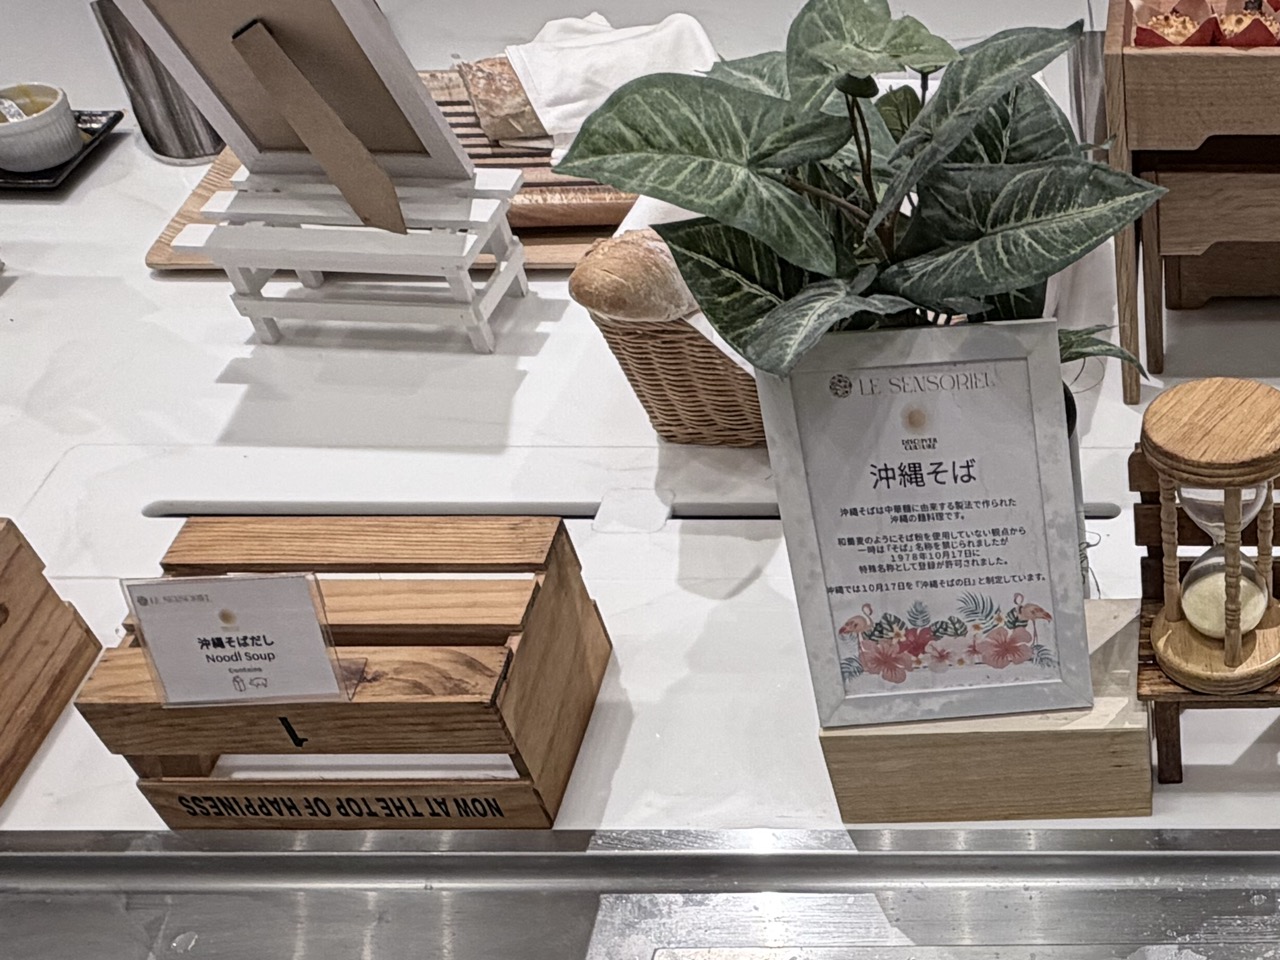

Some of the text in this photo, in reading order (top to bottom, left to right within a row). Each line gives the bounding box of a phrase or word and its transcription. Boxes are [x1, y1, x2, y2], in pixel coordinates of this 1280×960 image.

[859, 379, 881, 396] LE
[869, 458, 976, 489] 沖縄そば
[197, 634, 274, 650] 沖縄そばだし
[205, 651, 276, 664] Noodl Soup
[177, 795, 505, 818] NOW AT THE TOP OF HAPPINESS
